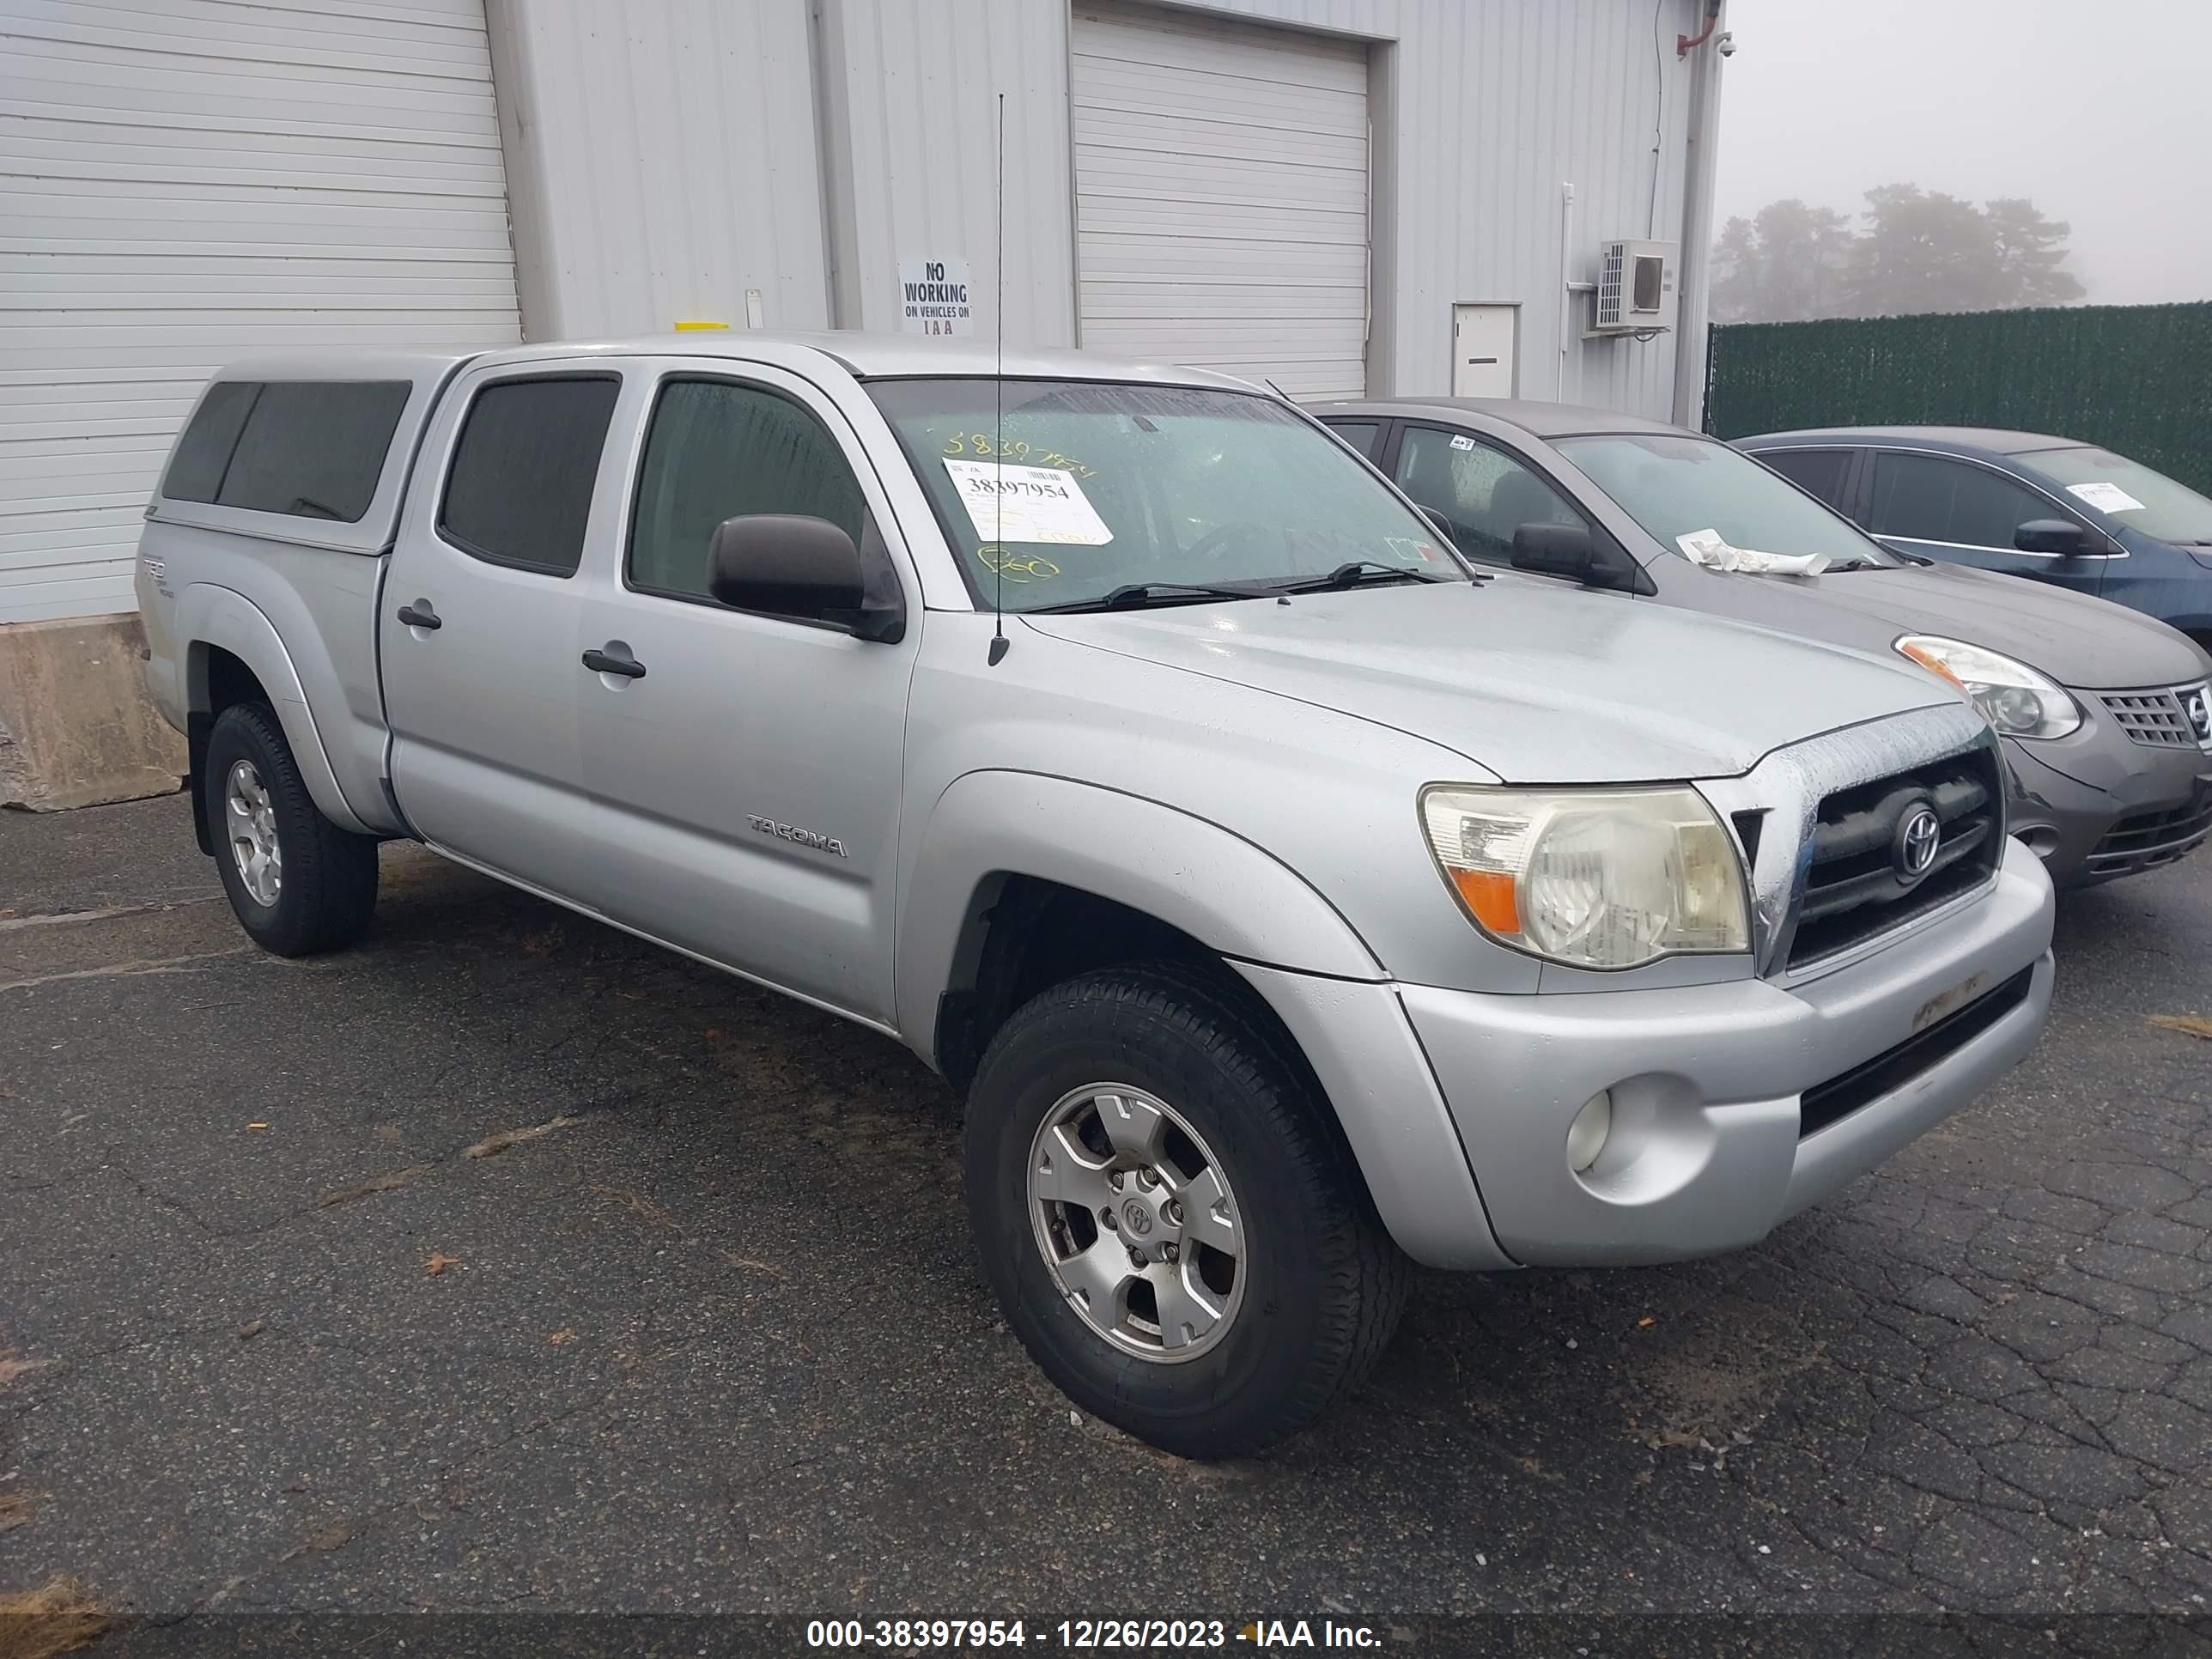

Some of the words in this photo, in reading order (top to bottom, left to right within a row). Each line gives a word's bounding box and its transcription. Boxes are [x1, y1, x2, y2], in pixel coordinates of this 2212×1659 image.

[926, 262, 945, 282] NO
[904, 283, 967, 303] WORKING
[905, 306, 918, 318] ON
[920, 306, 957, 318] VEHICLES
[958, 307, 969, 318] ON
[967, 477, 1070, 500] 38397954
[745, 812, 848, 858] TACOMA
